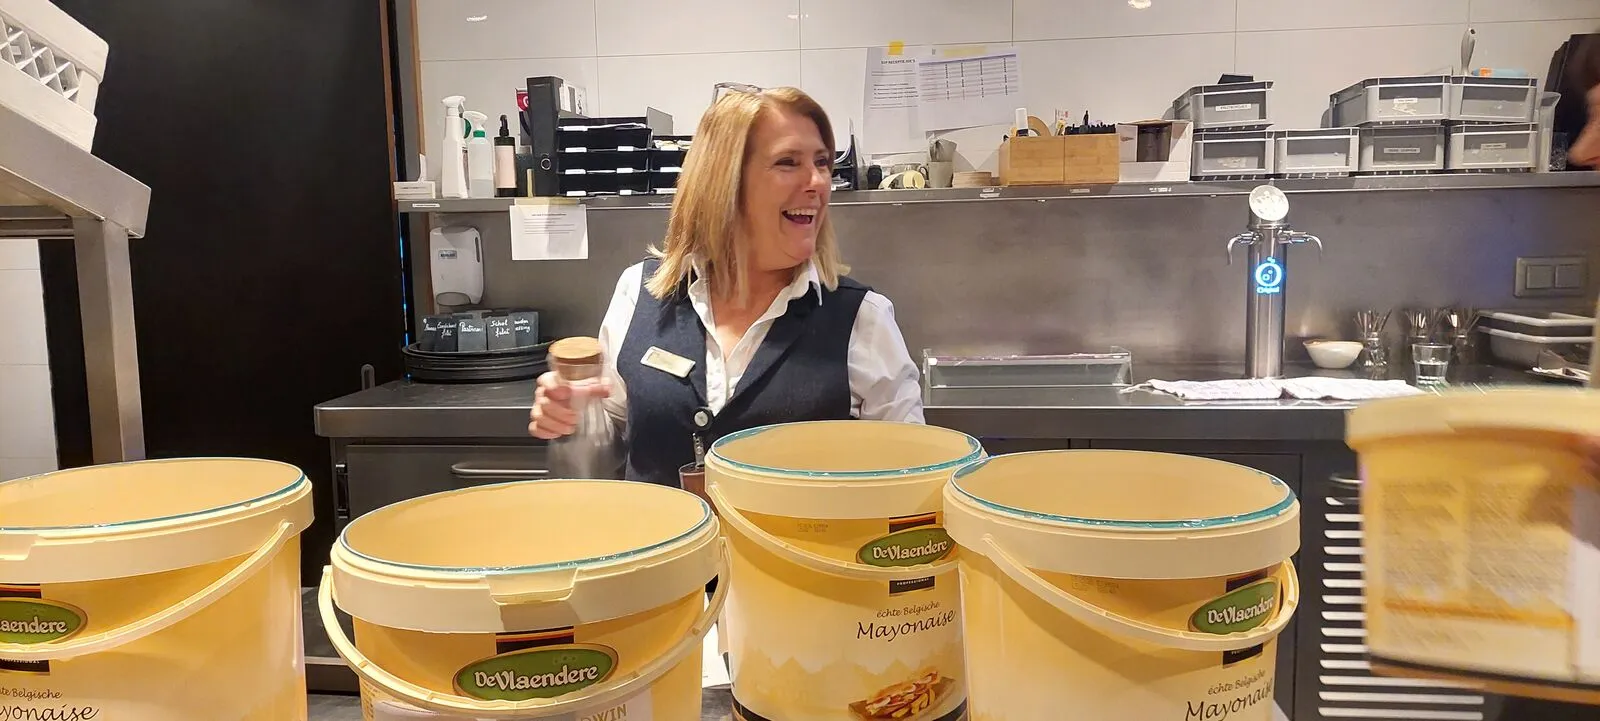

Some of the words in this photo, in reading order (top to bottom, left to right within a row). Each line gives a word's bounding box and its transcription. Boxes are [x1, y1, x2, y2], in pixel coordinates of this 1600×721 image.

[872, 540, 948, 561] DeVlaendere
[903, 600, 940, 616] Belgische
[0, 615, 68, 634] aendere
[856, 609, 956, 642] Mayonaise
[474, 665, 598, 691] DeVlaendere
[12, 687, 63, 701] Belgische
[0, 703, 99, 721] yonaise
